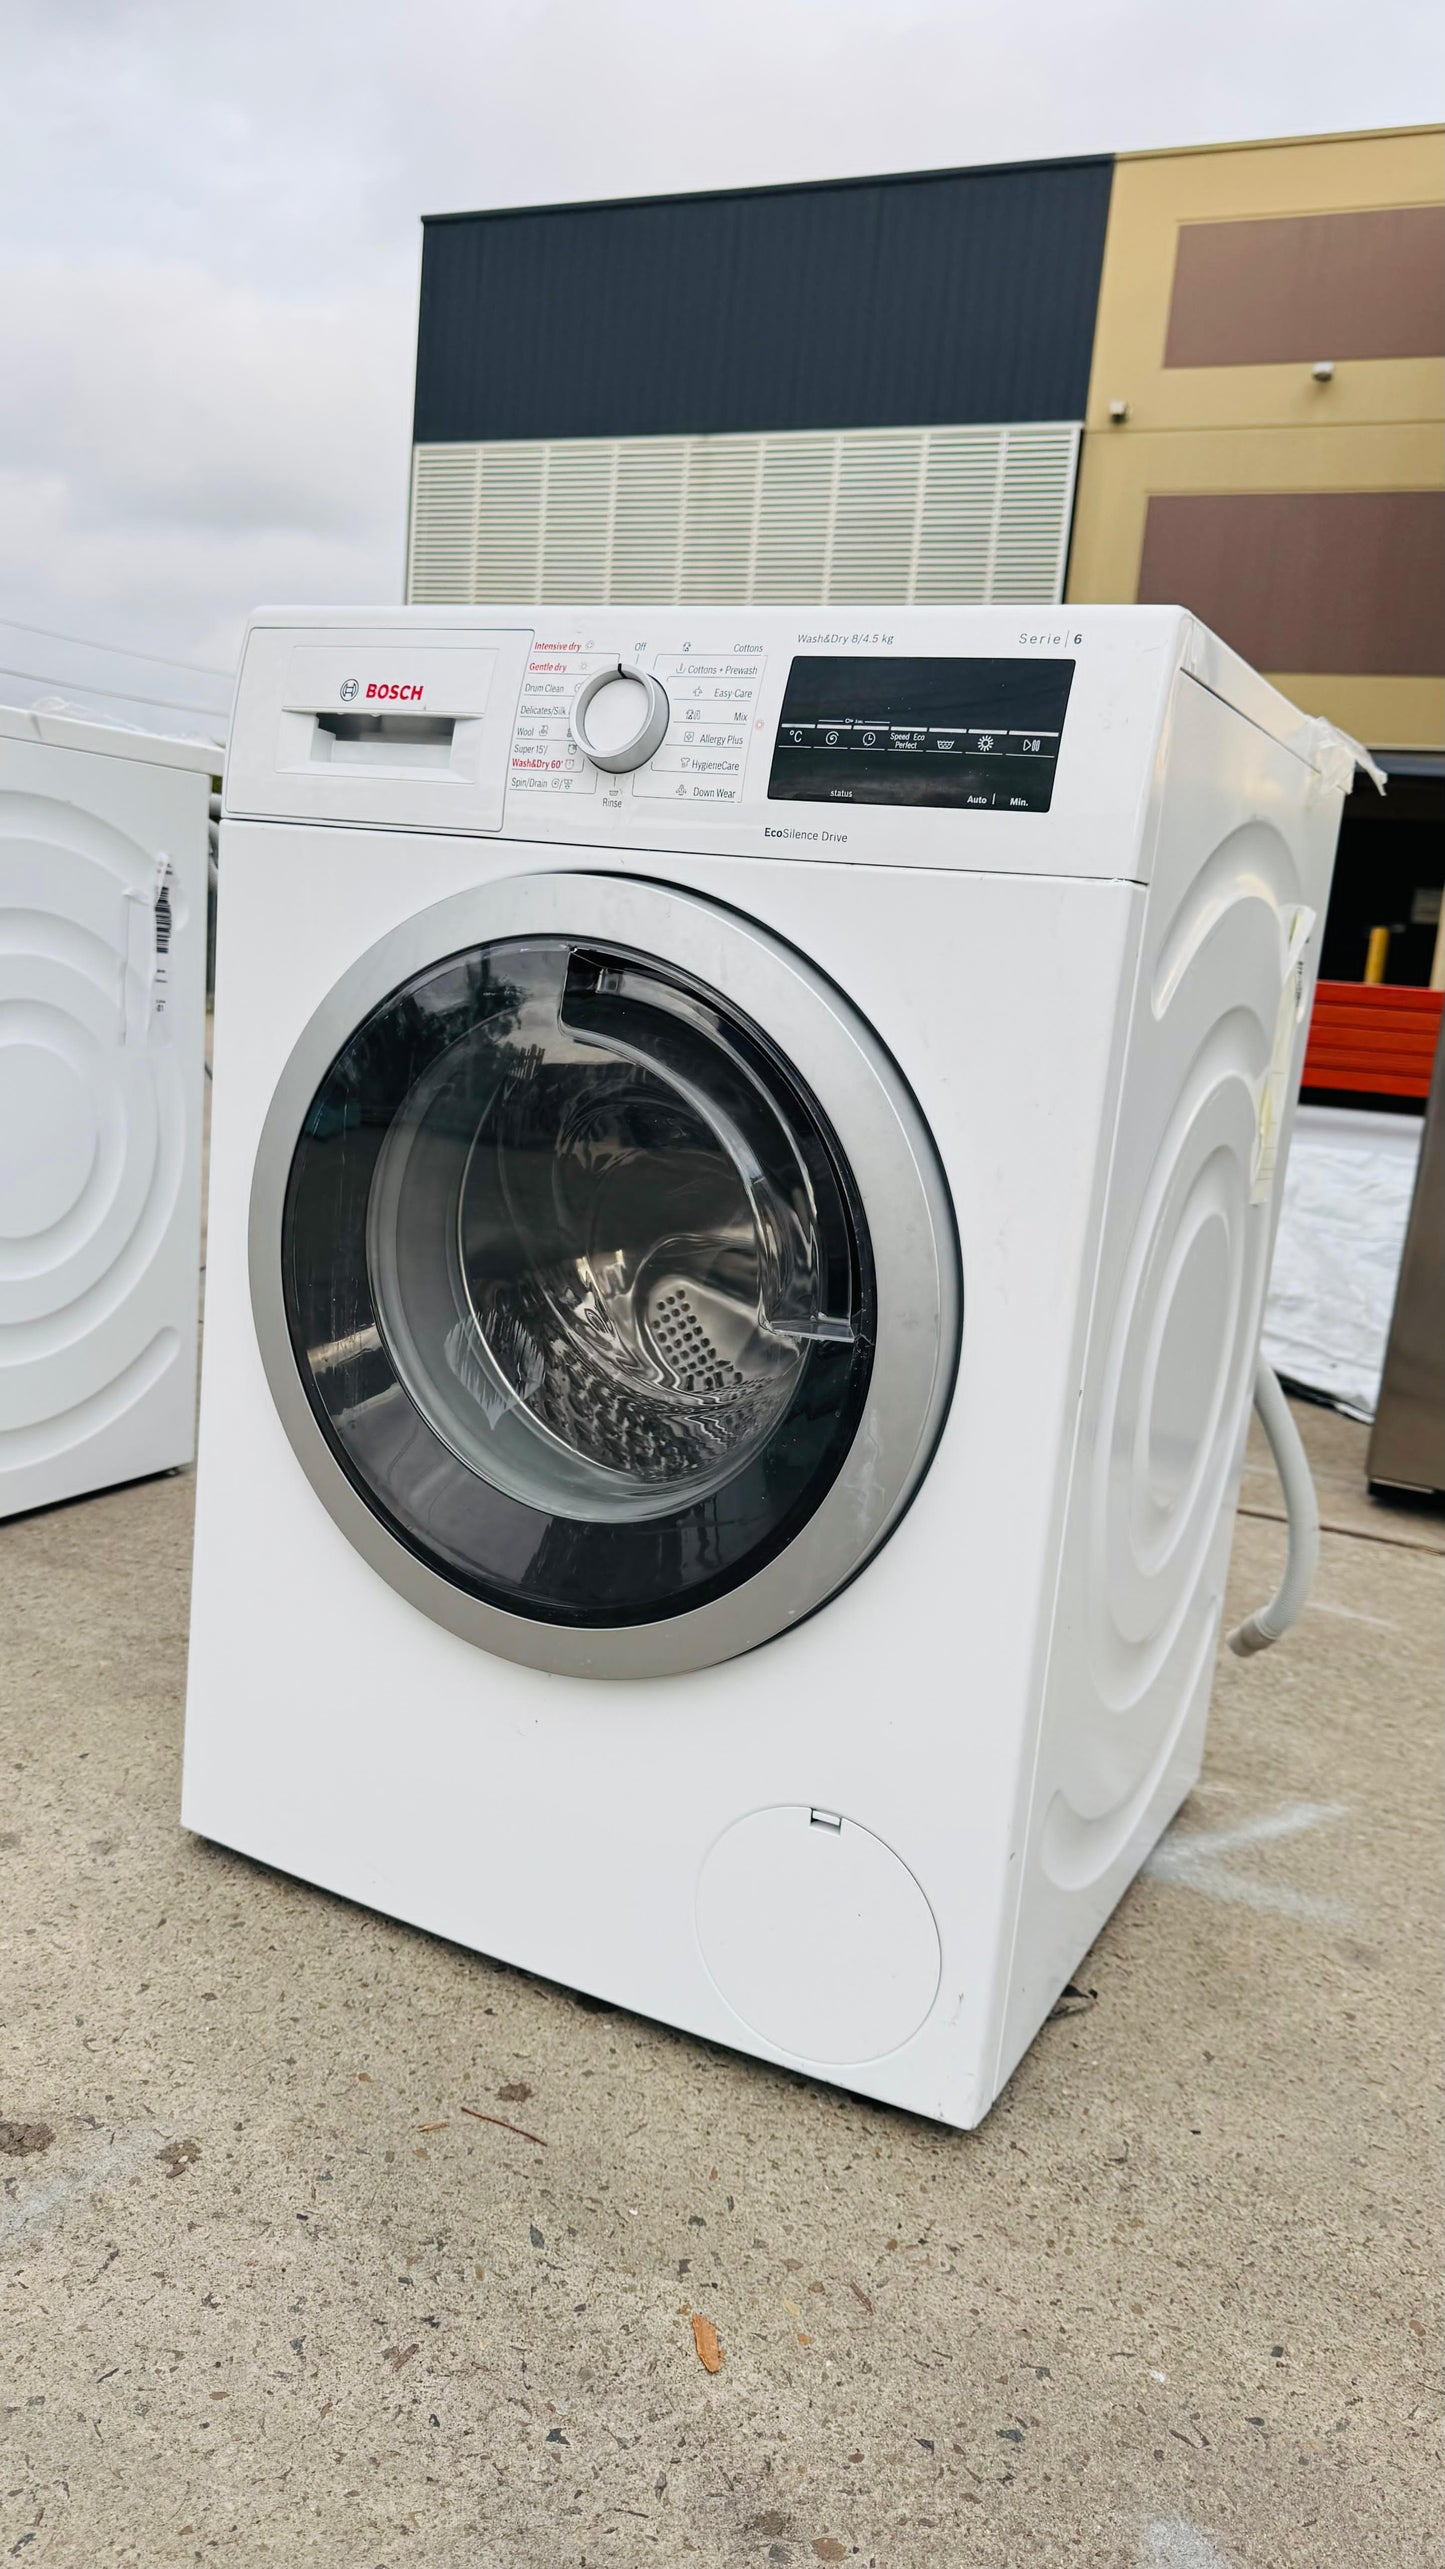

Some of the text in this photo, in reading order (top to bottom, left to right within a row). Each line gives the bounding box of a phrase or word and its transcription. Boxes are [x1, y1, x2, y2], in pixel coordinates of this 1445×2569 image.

[797, 634, 895, 645] Wash&Dry 8/4.5 kg
[1018, 632, 1083, 645] Serie 6
[534, 641, 582, 652] Intensive dry
[634, 641, 647, 651] Off
[733, 643, 763, 653] Cottons
[529, 662, 567, 673] Gentle dry
[687, 665, 717, 675] Cottons
[725, 665, 758, 675] Prewash
[365, 683, 424, 701] BOSCH
[524, 683, 565, 693] Drum Clean
[714, 688, 752, 699] Easy Care
[520, 705, 566, 716] Delicates/Silk
[733, 712, 748, 721] Mix
[517, 727, 534, 737] Wool
[889, 732, 926, 743] Speed Eco
[700, 734, 744, 746] Allergy Plus
[894, 741, 918, 750] Perfect
[514, 744, 535, 755] Super
[511, 758, 550, 770] Wash&Dry
[691, 759, 740, 772] HygieneCare
[511, 777, 548, 789] Spin/Drain
[693, 786, 736, 798] Down Wear
[830, 790, 853, 798] status
[602, 797, 623, 808] Rinse
[966, 795, 1029, 807] Auto Min.
[764, 827, 848, 843] EcoSilence Drive
